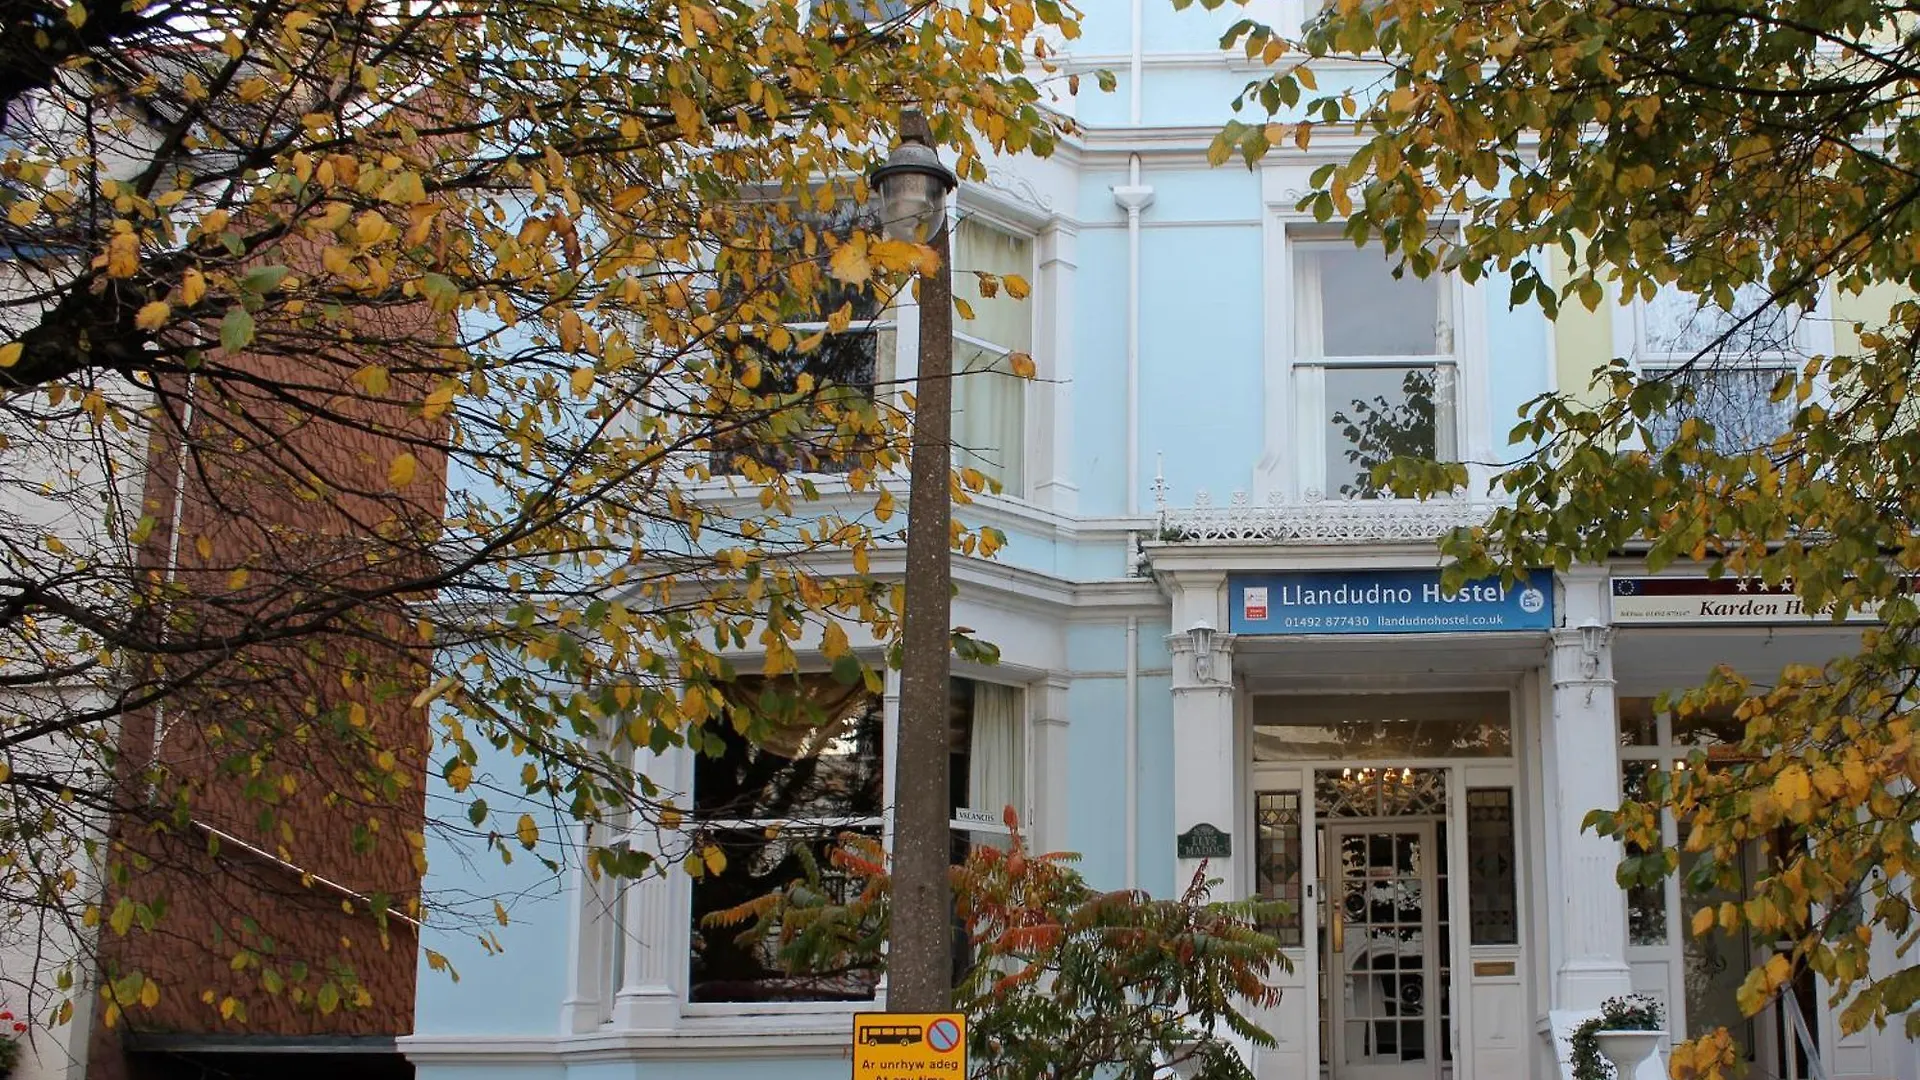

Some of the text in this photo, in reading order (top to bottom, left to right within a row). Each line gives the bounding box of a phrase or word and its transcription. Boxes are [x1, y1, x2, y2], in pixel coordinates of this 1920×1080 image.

[1282, 583, 1412, 606] Llandudno
[1700, 600, 1778, 616] Karden
[1284, 614, 1504, 628] 01492 877430 llandudnohostel.co.uk
[862, 1059, 958, 1071] Ar unrhyw adeg
